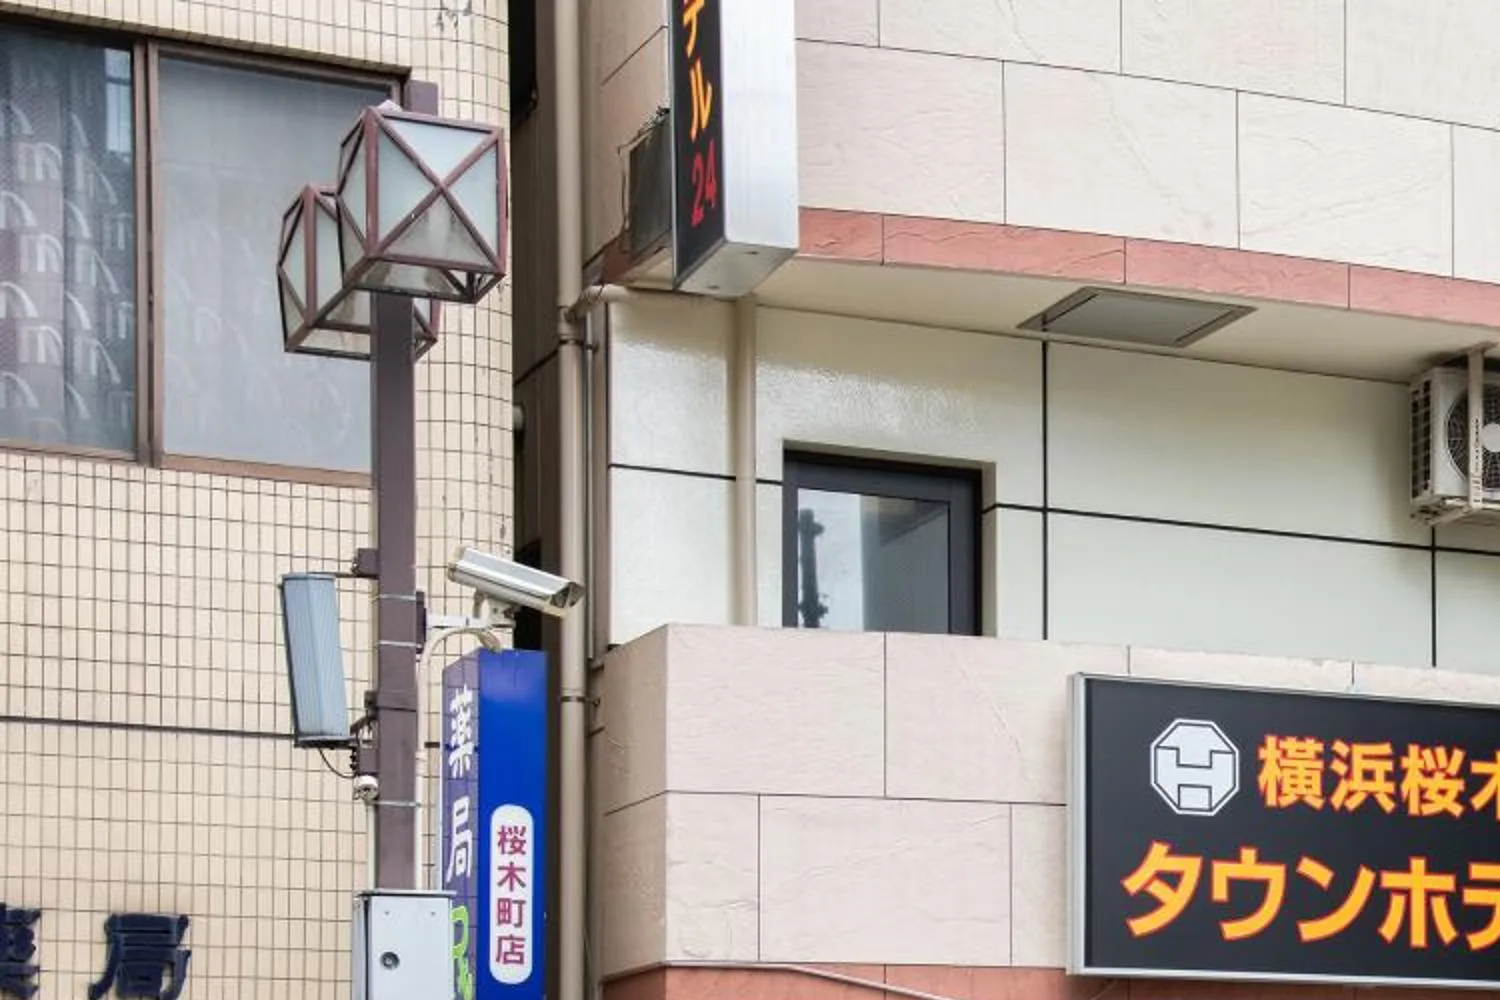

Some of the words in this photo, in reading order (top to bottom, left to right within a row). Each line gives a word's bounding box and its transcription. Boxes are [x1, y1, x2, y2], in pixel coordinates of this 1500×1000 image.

[448, 684, 474, 884] 薬局
[495, 824, 527, 966] 桜木町店
